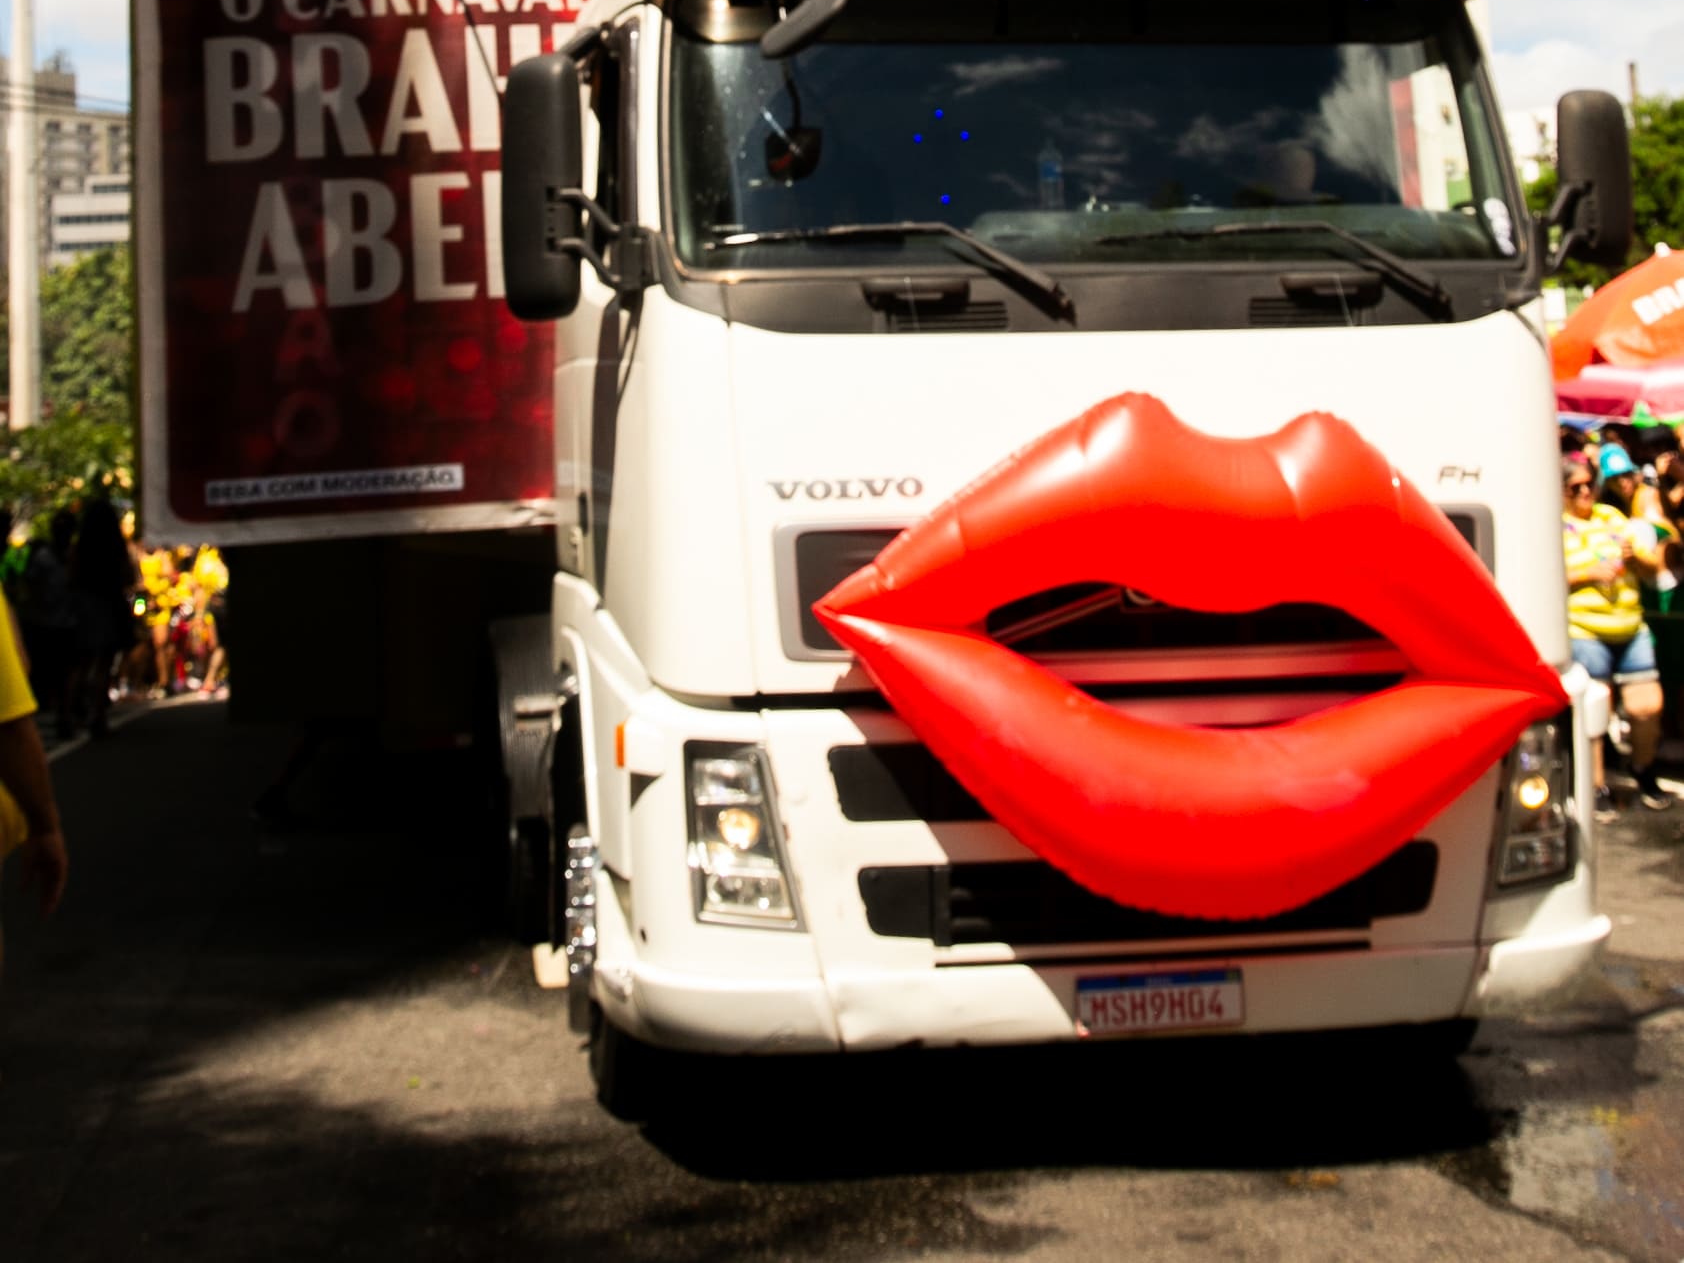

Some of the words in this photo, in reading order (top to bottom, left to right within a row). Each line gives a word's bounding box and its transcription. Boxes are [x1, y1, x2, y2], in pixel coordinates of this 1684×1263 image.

[208, 484, 264, 502] BEBA
[268, 478, 317, 497] COM
[767, 477, 923, 501] VOLVO
